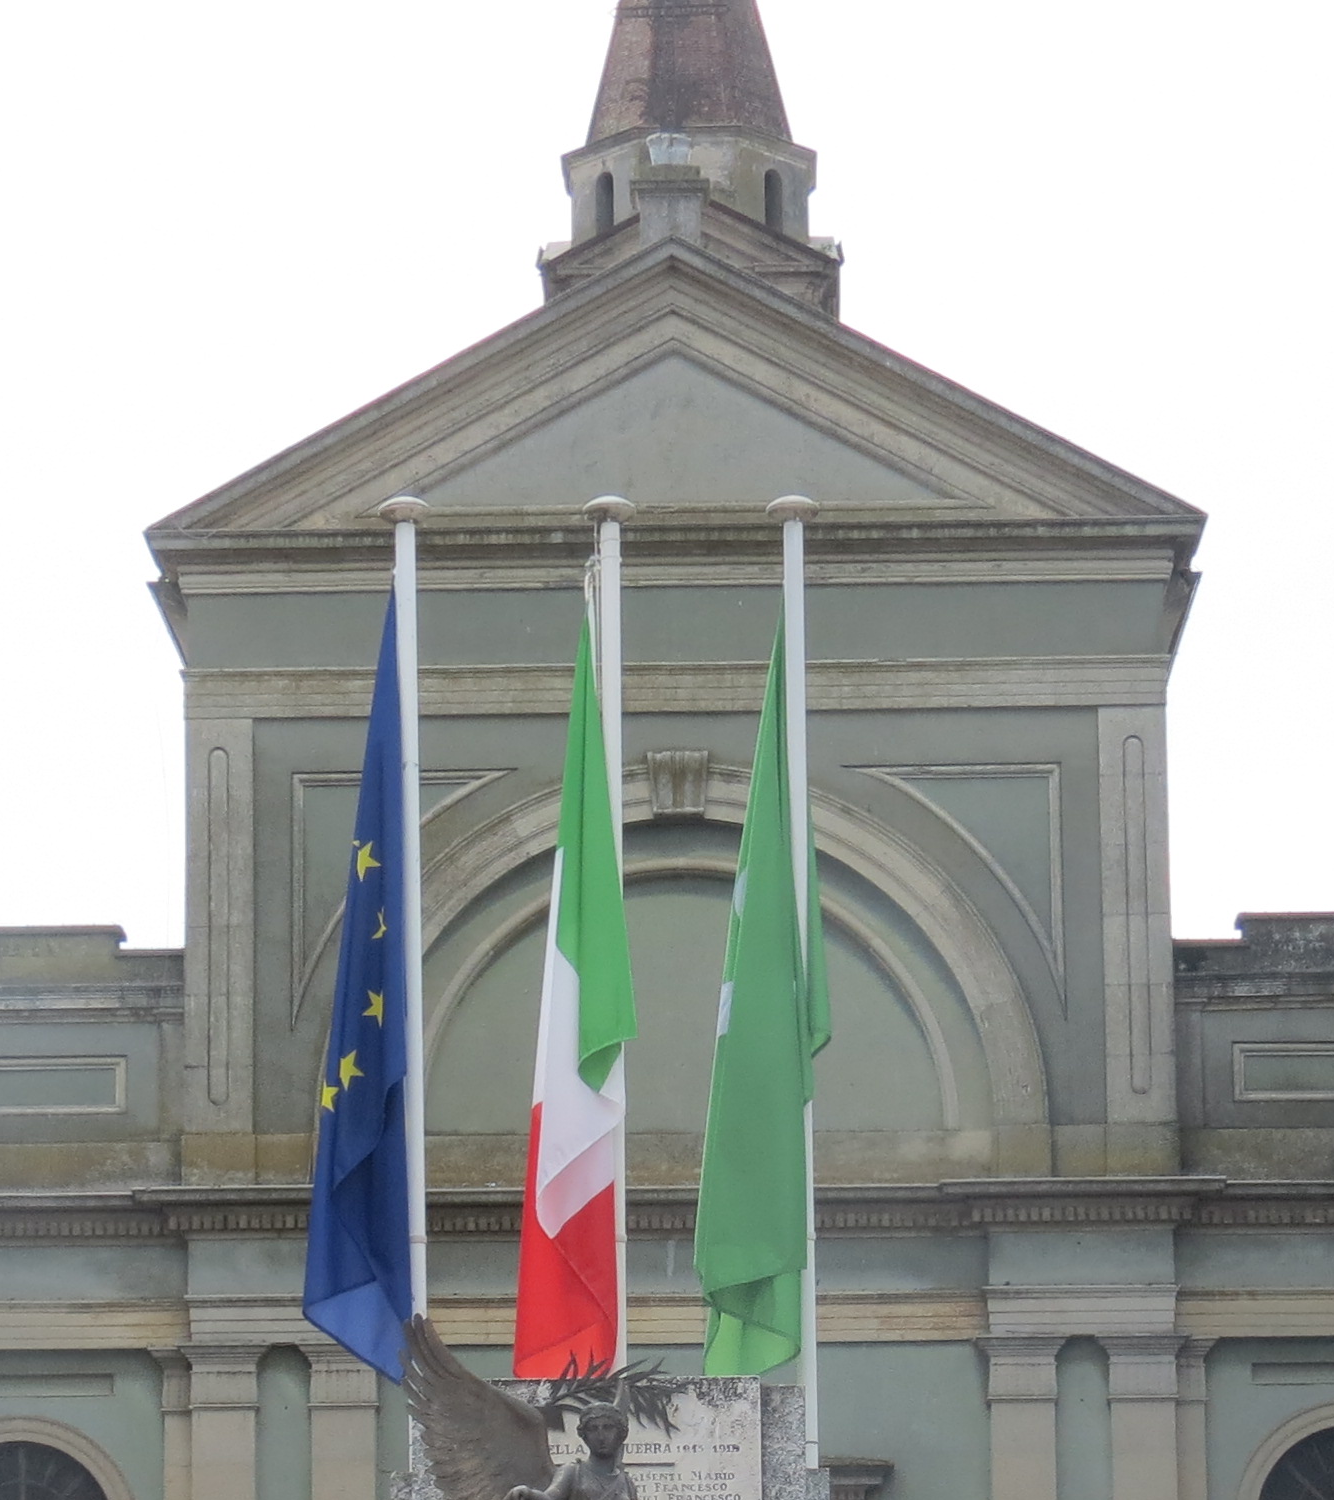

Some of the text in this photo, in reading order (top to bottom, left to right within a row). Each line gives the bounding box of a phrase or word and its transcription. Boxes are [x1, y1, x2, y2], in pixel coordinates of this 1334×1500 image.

[548, 1443, 587, 1455] ELLA
[624, 1443, 672, 1455] UERRA
[690, 1471, 735, 1481] MARIO
[655, 1482, 728, 1493] FRANCESCO
